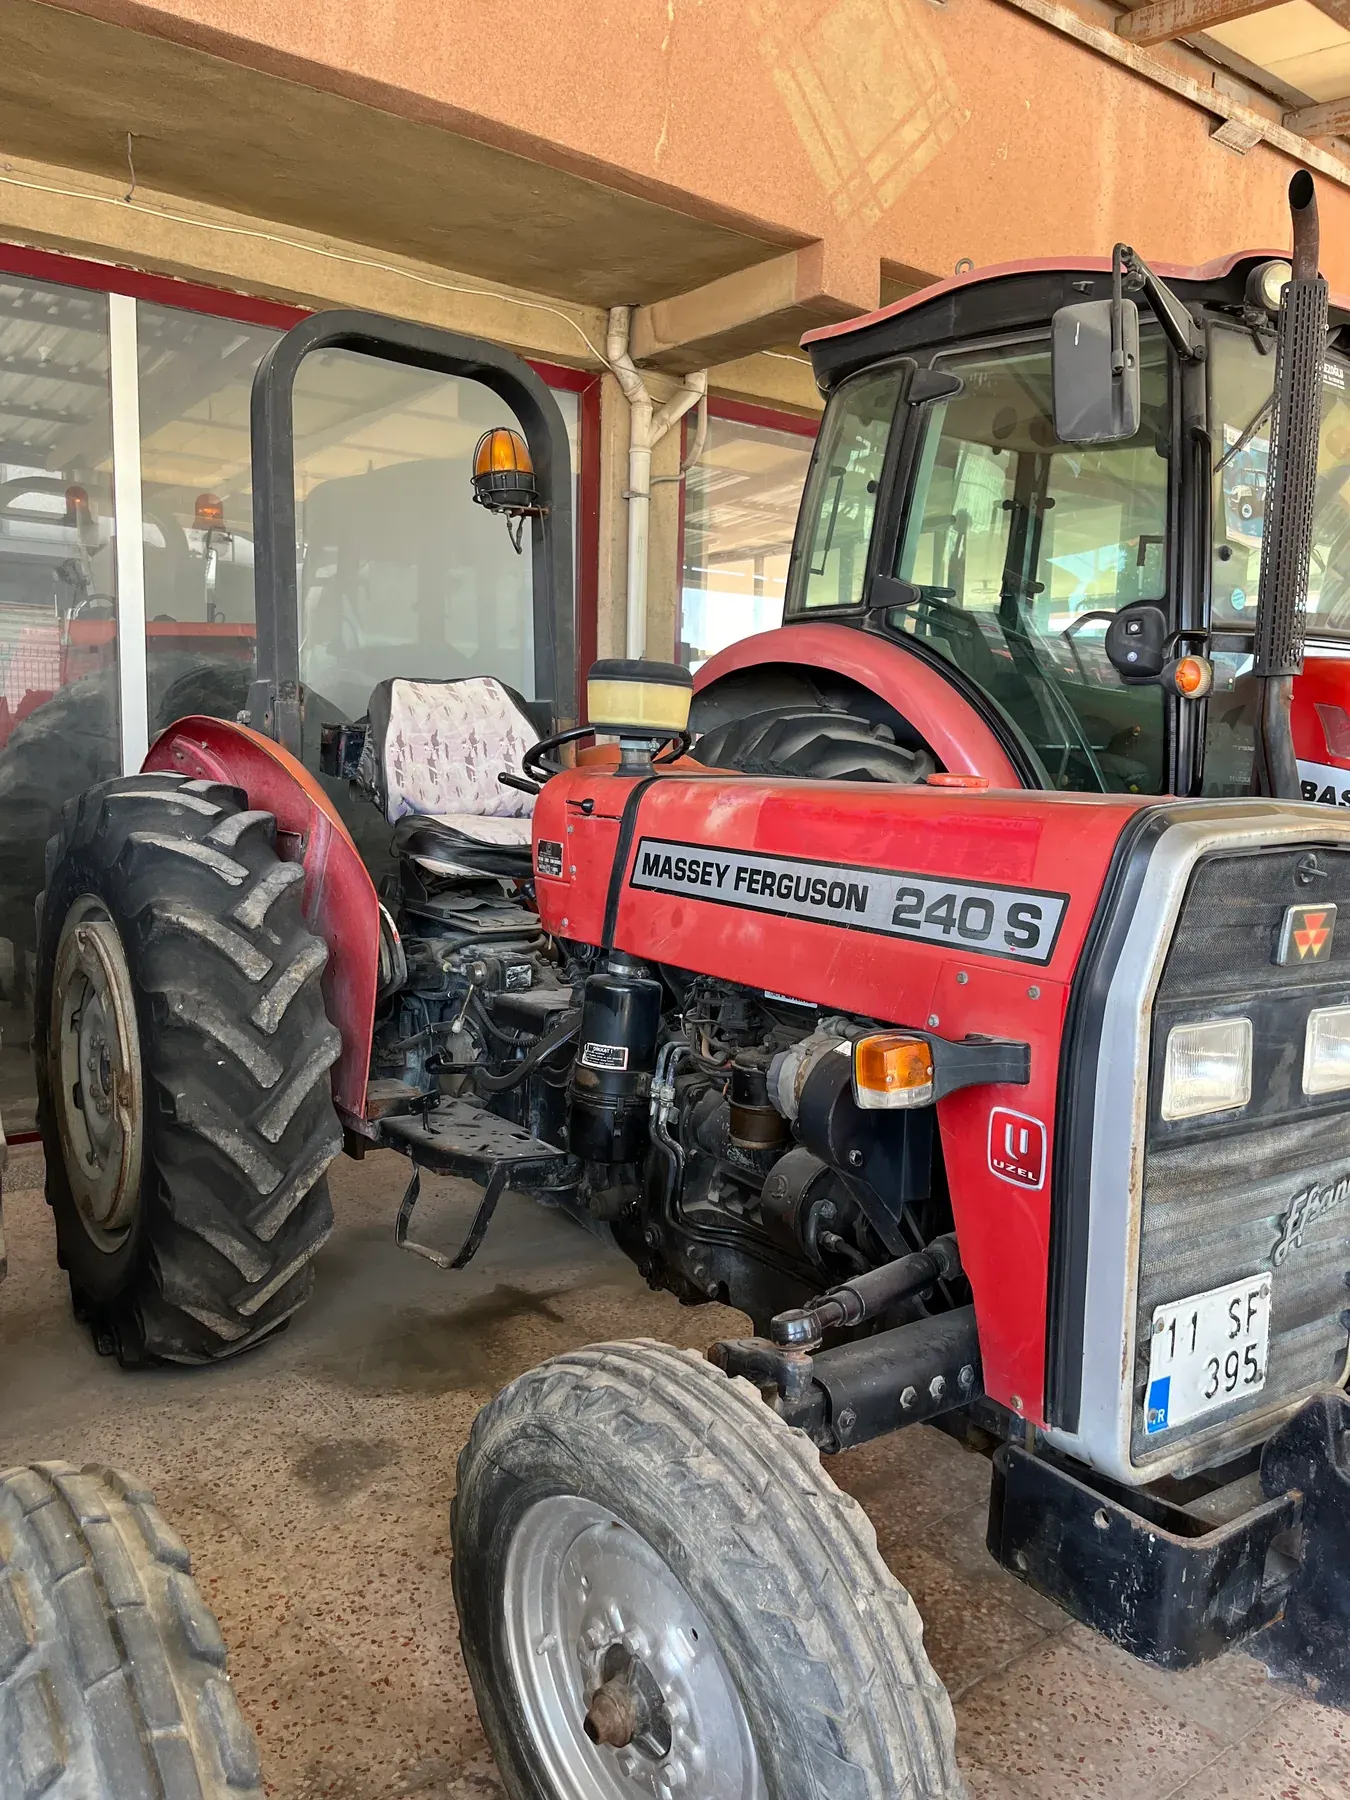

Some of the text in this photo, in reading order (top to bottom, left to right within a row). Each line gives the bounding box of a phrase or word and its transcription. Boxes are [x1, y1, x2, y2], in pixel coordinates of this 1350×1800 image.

[641, 852, 1043, 949] MASSEY FERGUSON 240 S
[992, 1158, 1037, 1182] UZEL
[1271, 1178, 1350, 1267] Efsan
[1228, 1290, 1260, 1340] SF
[1204, 1342, 1259, 1399] 395
